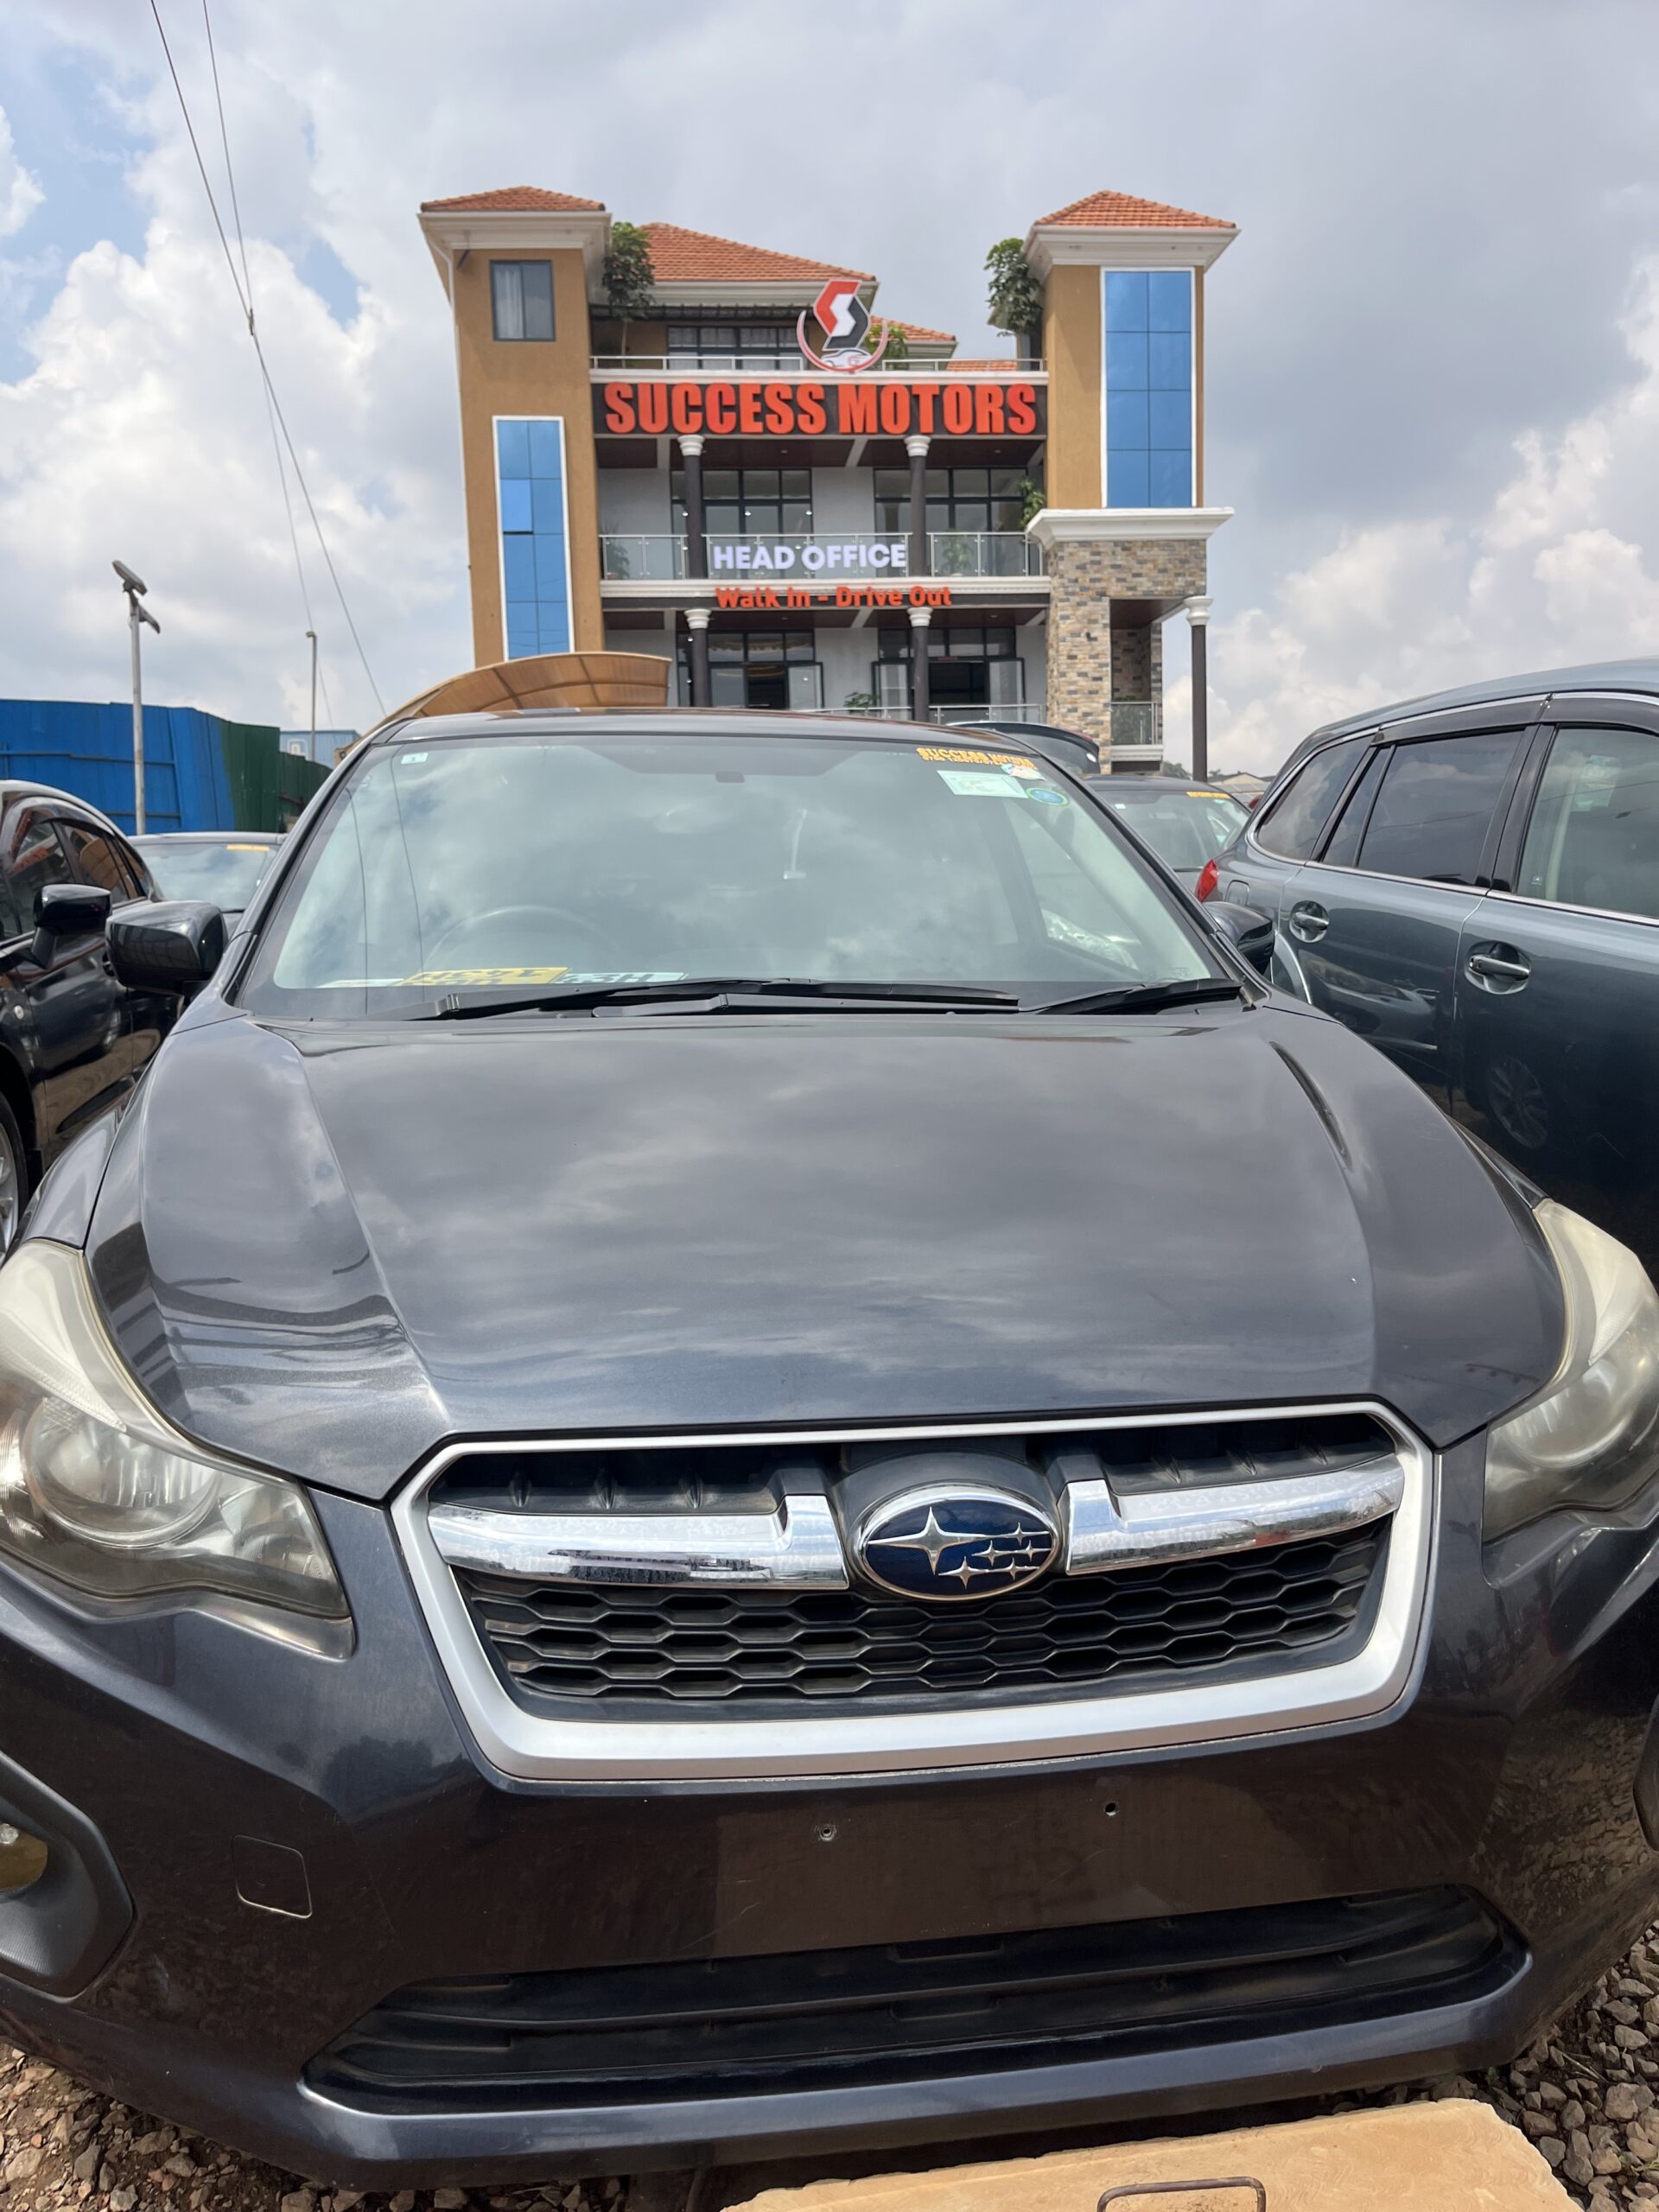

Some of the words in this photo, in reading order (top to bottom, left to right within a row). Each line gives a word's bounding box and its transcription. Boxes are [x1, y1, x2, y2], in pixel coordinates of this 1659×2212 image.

[605, 382, 827, 435] SUCCESS
[837, 384, 1036, 435] MOTORS
[713, 545, 795, 570] HEAD
[801, 543, 906, 570] OFFICE
[715, 588, 779, 608] Walk
[787, 587, 810, 607] In
[836, 587, 903, 607] Drive
[909, 586, 951, 607] Out
